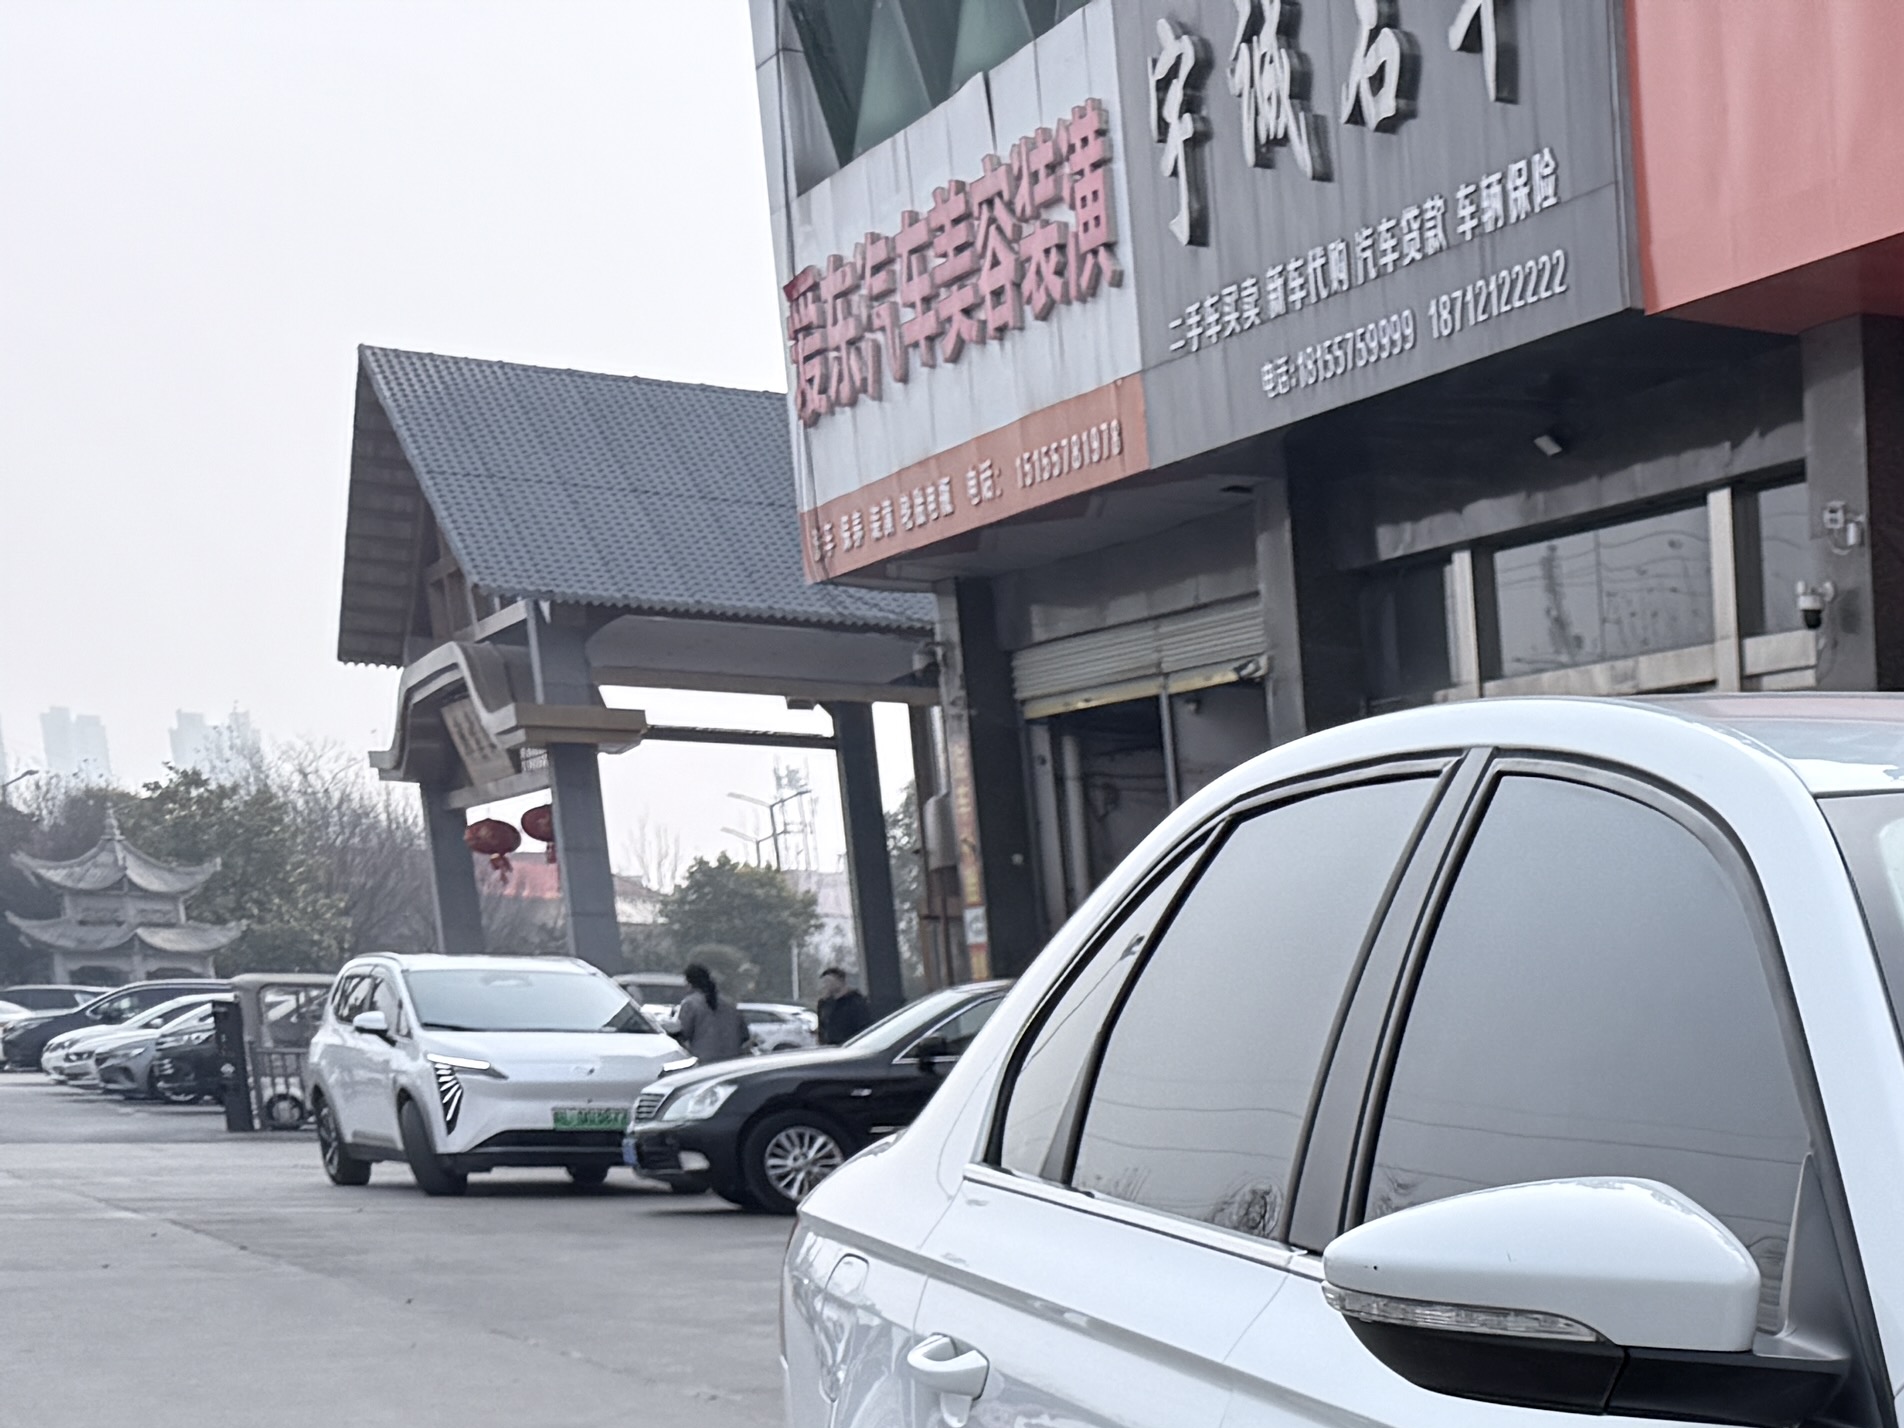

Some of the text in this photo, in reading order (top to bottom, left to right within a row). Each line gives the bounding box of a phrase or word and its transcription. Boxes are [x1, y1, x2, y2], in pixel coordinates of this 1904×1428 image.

[1168, 147, 1559, 352] 二手车买卖 新车代购 汽车贷款 车辆保险
[1427, 249, 1568, 339] 18712122222
